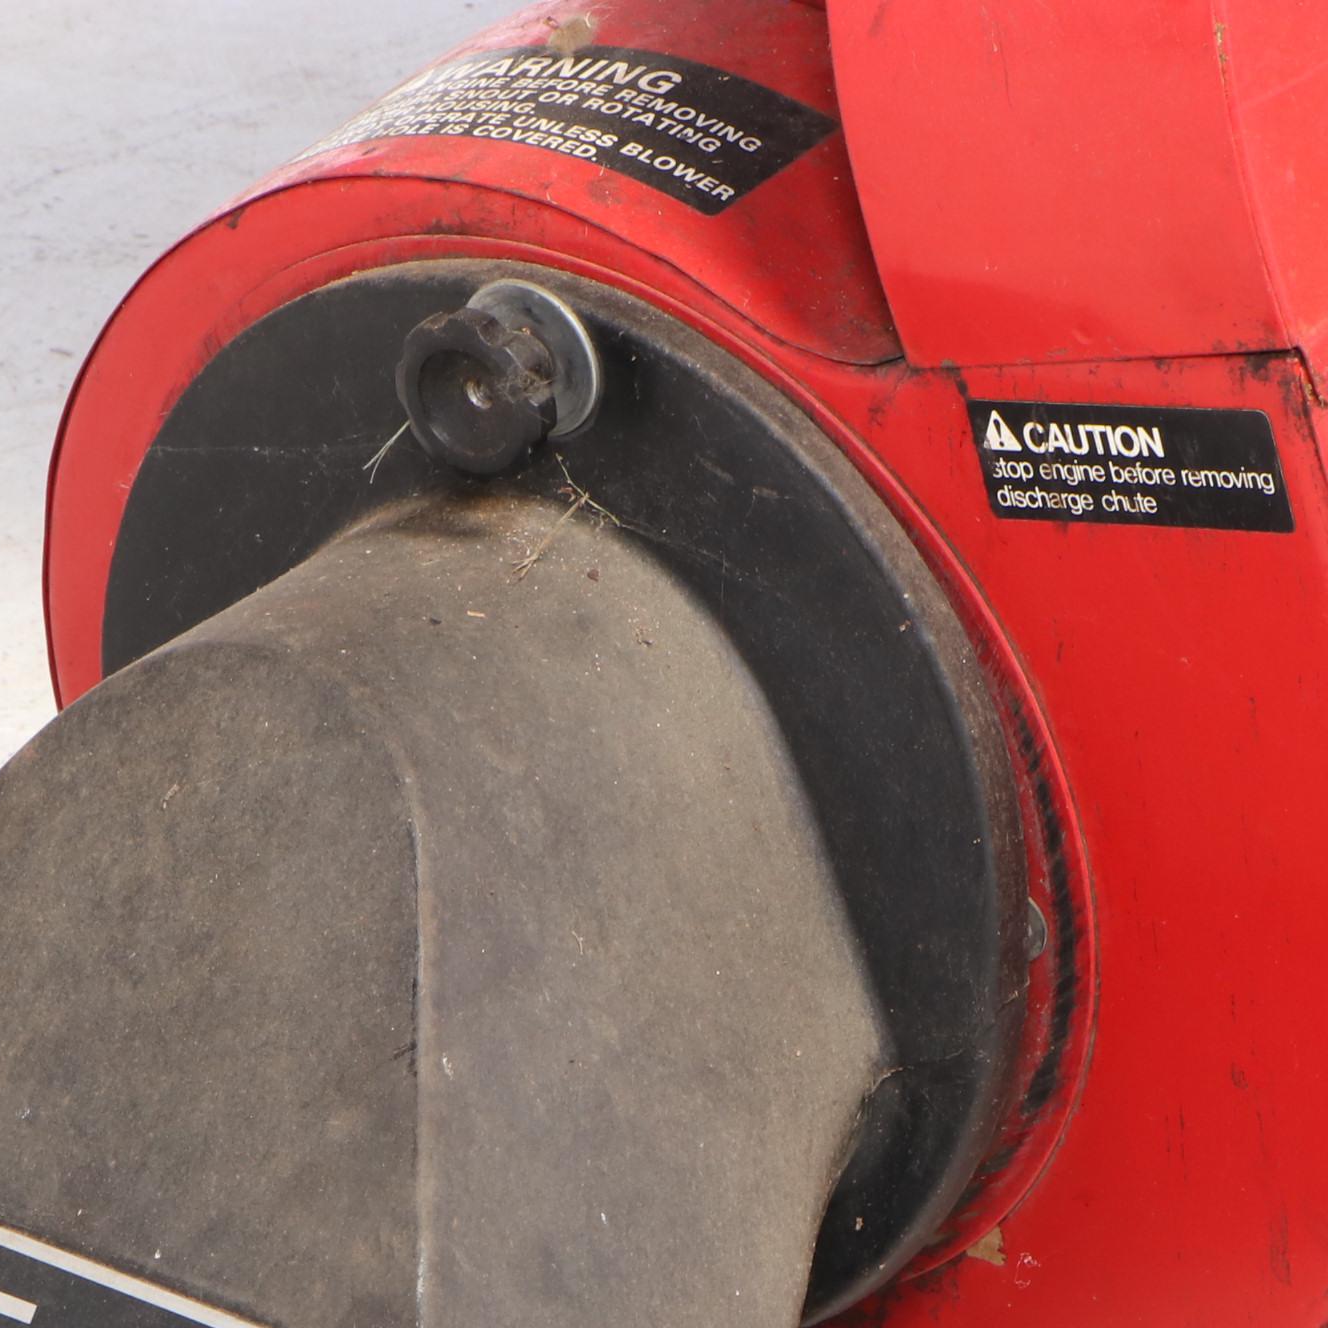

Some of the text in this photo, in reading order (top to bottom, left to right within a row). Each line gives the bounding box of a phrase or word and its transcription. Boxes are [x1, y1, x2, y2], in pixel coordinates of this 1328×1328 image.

[416, 100, 536, 114] HOUSING.
[444, 89, 722, 154] SNOUT OR ROTATING
[510, 77, 614, 97] BEFORE
[614, 88, 762, 153] REMOVING
[394, 112, 512, 127] OPERATE
[512, 115, 618, 148] UNLESS
[619, 142, 736, 202] BLOWER
[440, 123, 470, 135] IS
[472, 124, 598, 162] COVERED.
[1022, 421, 1165, 458] CAUTION
[991, 457, 1276, 494] stop engine before removing
[996, 484, 1158, 515] discharge chute
